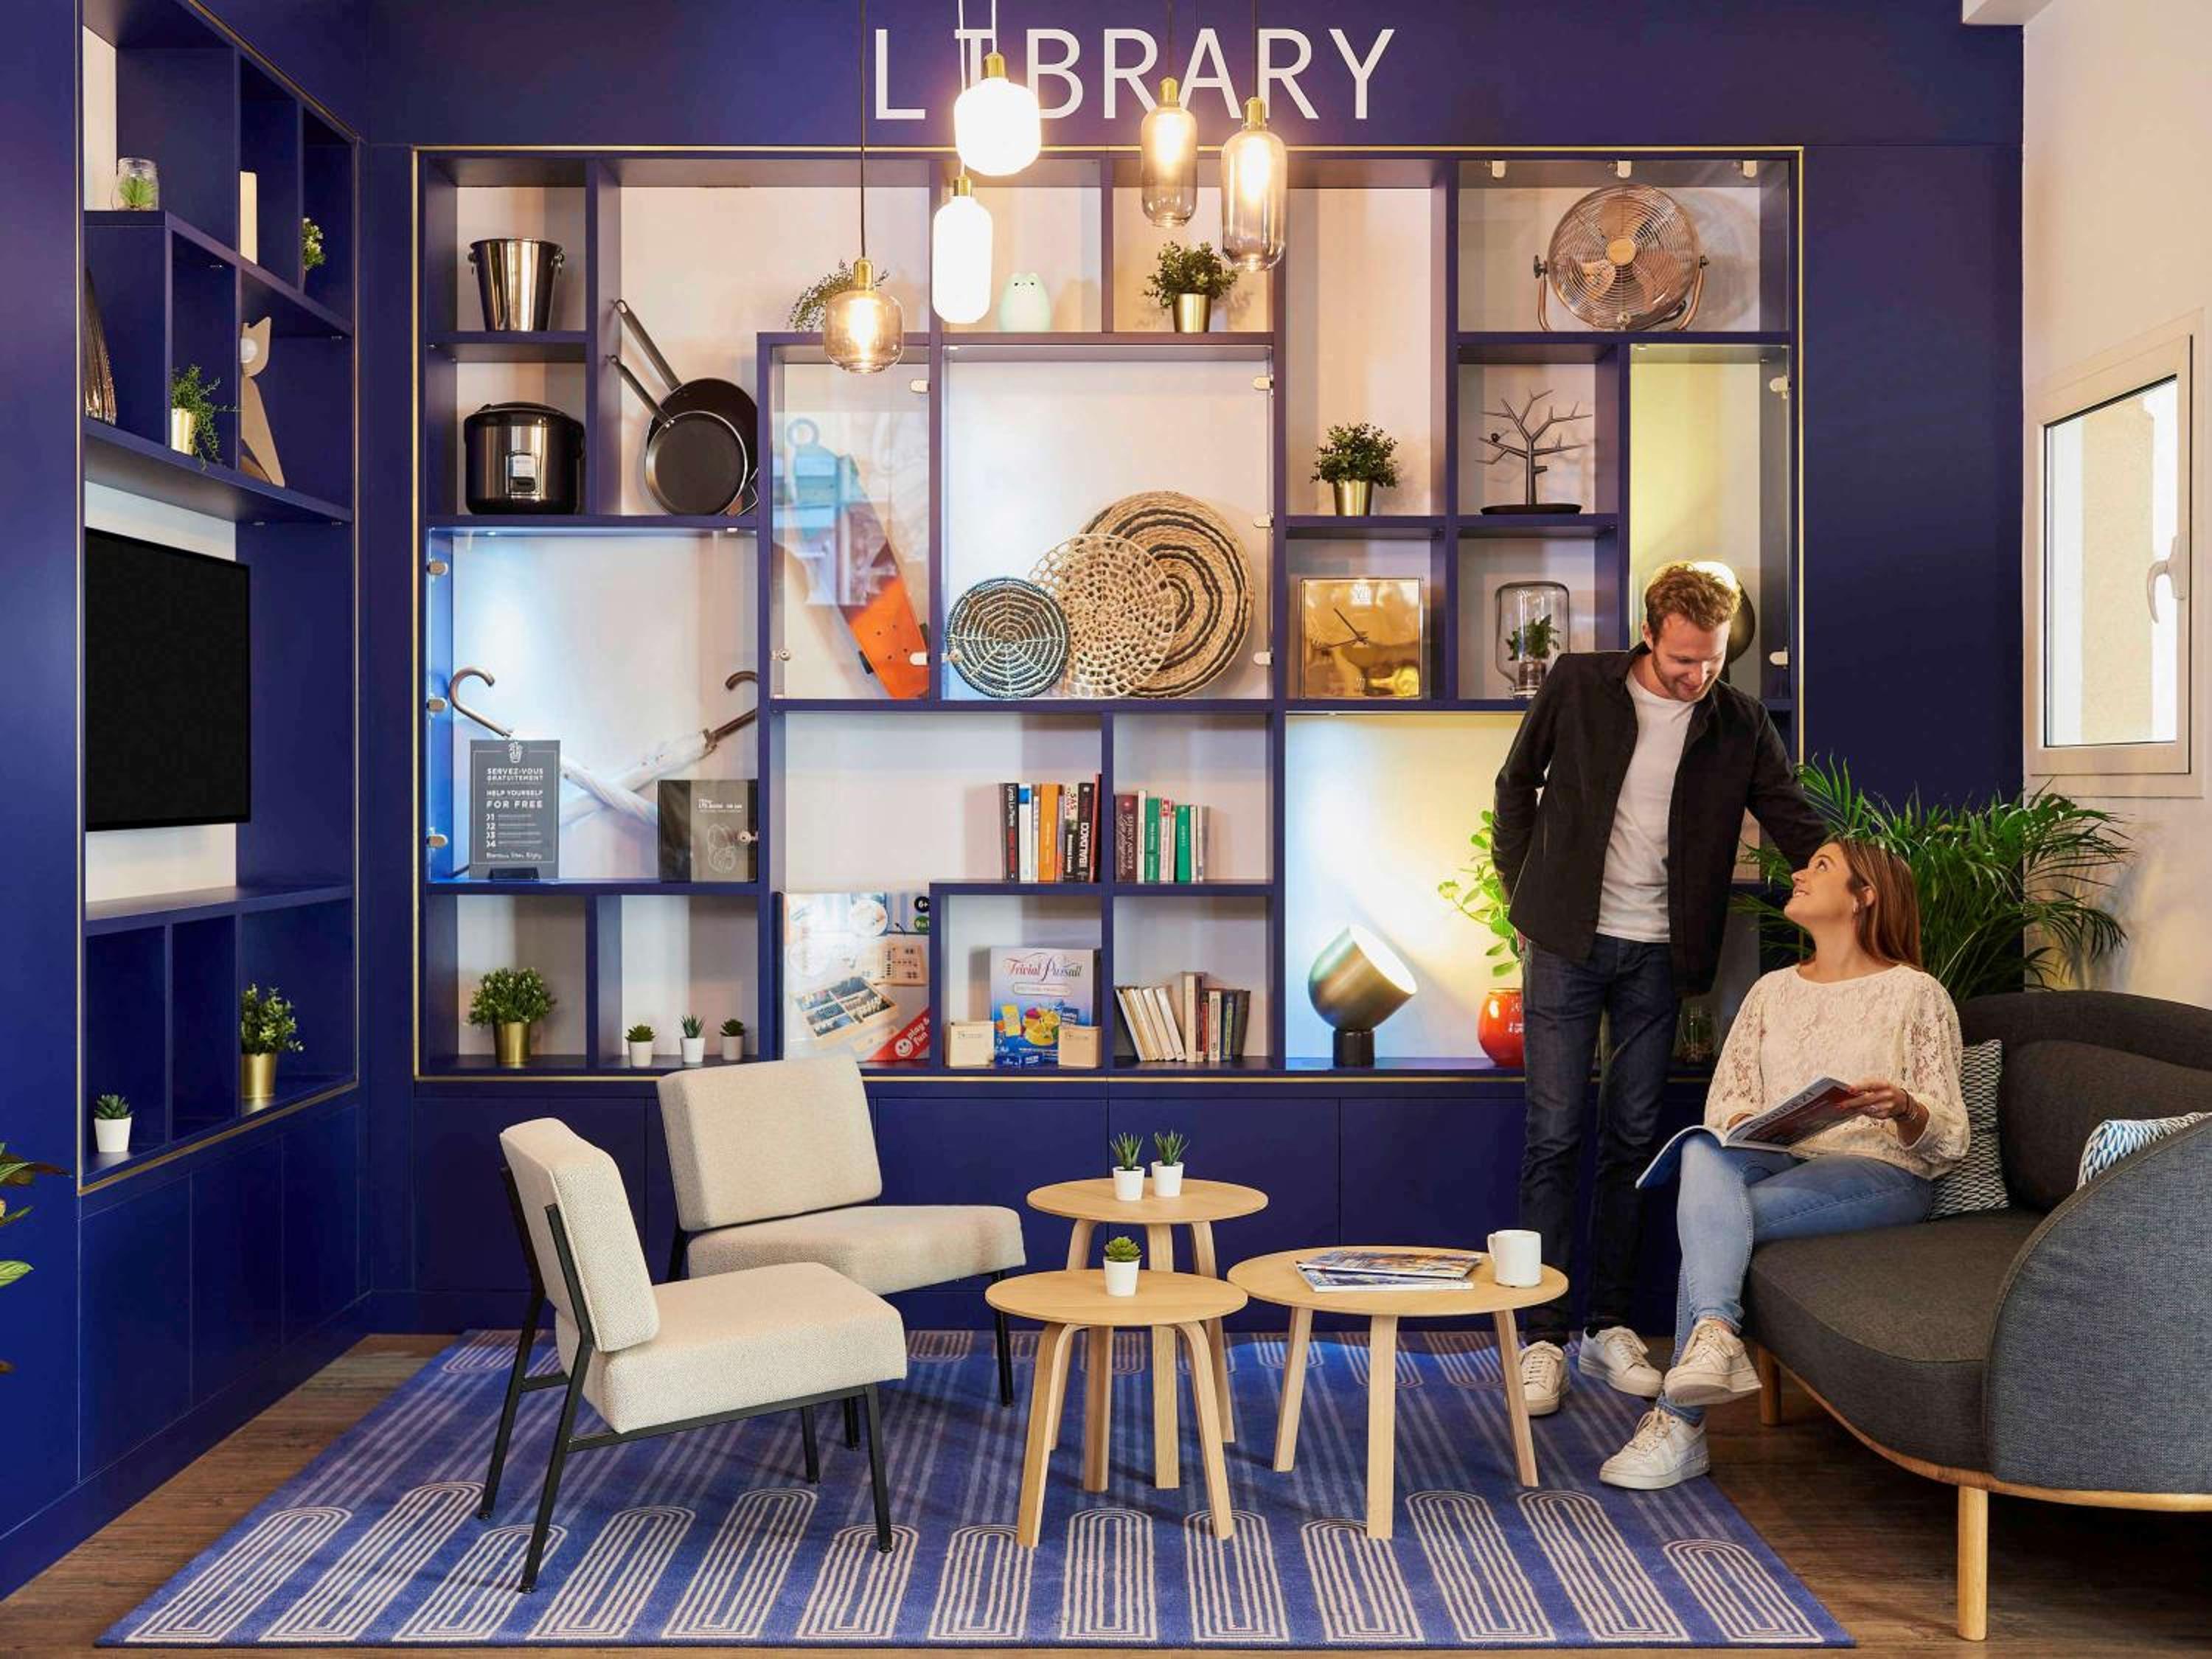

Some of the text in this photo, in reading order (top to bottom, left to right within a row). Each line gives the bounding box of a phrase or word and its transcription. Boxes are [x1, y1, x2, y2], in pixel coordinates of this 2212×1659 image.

[486, 800, 543, 809] FOR FREE
[918, 900, 929, 908] 6+
[1003, 958, 1042, 975] Trivial
[908, 1022, 925, 1040] play
[914, 1032, 928, 1046] fun
